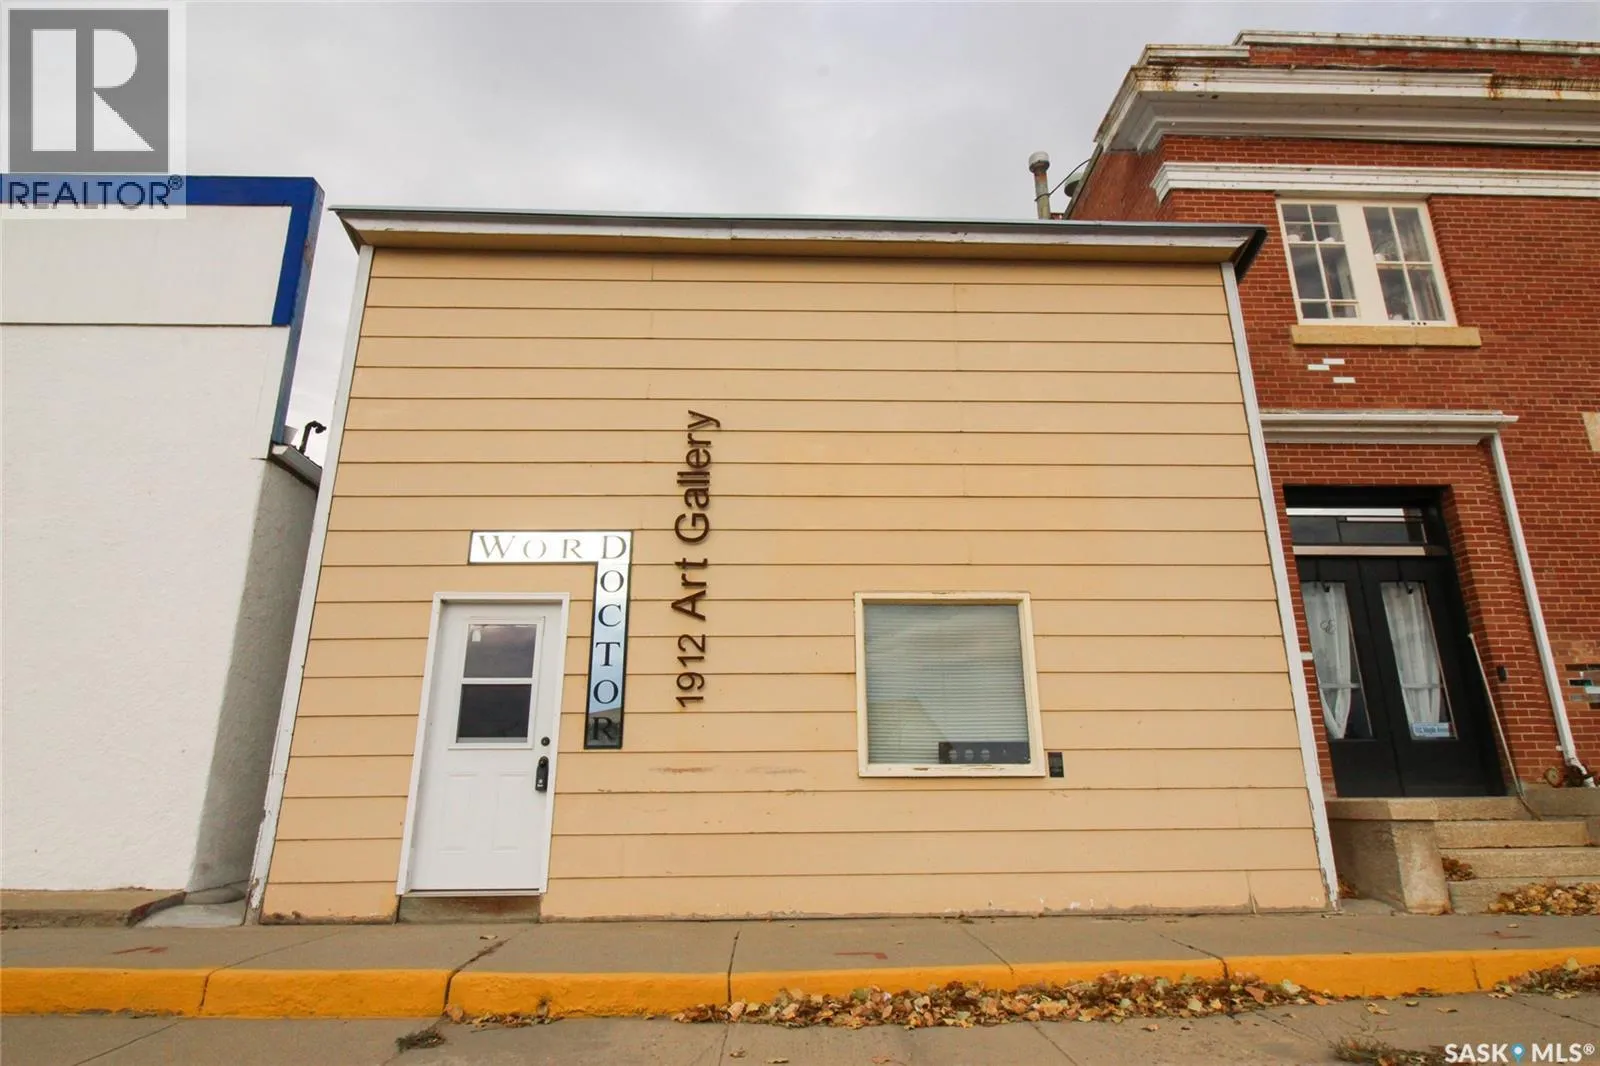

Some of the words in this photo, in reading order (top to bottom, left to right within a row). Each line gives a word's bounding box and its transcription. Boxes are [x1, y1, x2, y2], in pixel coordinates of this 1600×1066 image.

[674, 409, 720, 544] Gallery
[479, 535, 627, 559] WORD
[671, 557, 708, 622] Art
[675, 634, 705, 708] 1912
